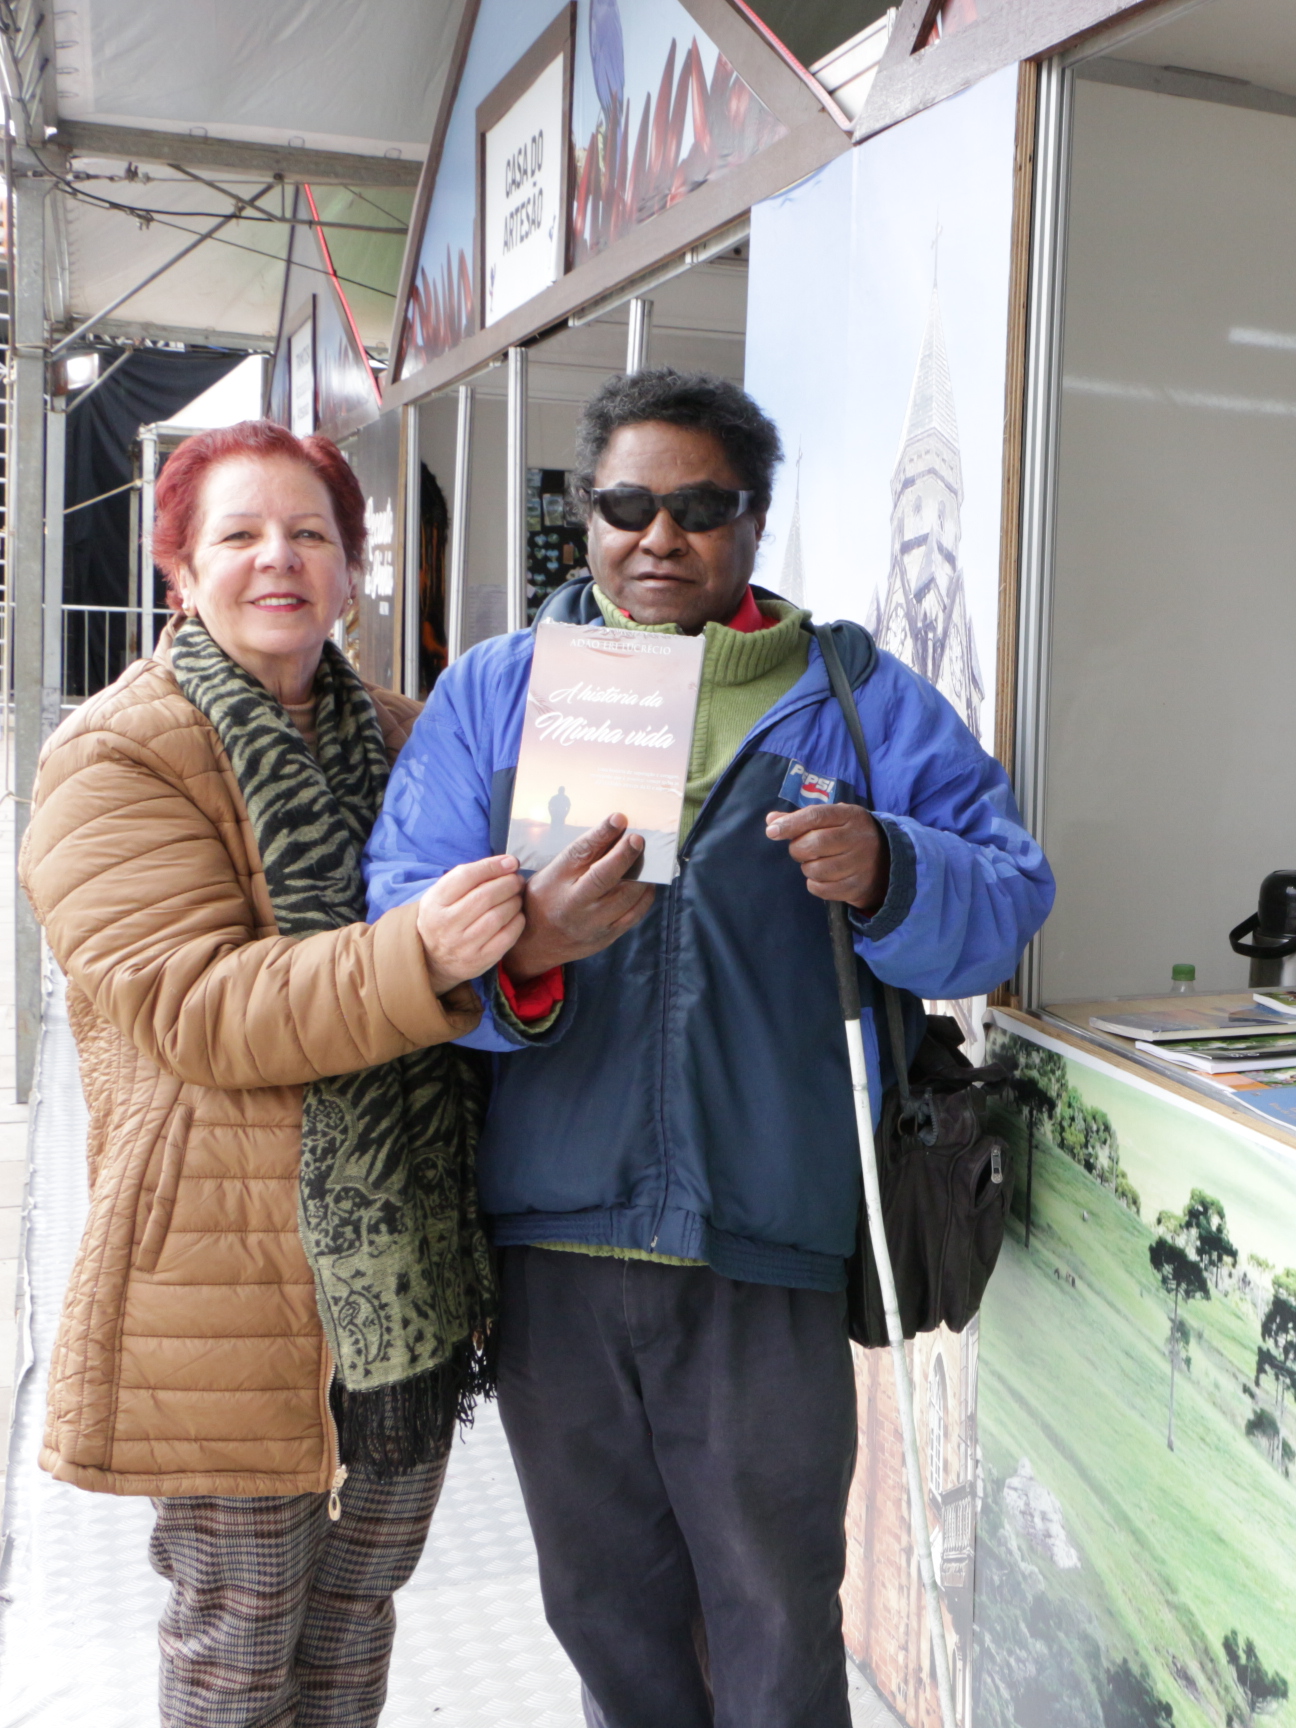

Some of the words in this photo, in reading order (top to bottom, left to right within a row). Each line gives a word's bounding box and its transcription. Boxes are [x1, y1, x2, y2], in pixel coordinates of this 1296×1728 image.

[505, 142, 528, 199] CASA
[531, 129, 544, 178] DO
[502, 181, 543, 256] ARTESÃO
[549, 681, 583, 704] A
[577, 684, 638, 706] história
[639, 690, 664, 708] da
[535, 712, 624, 746] Minha
[624, 724, 676, 749] vida
[790, 764, 835, 793] PEPSI
